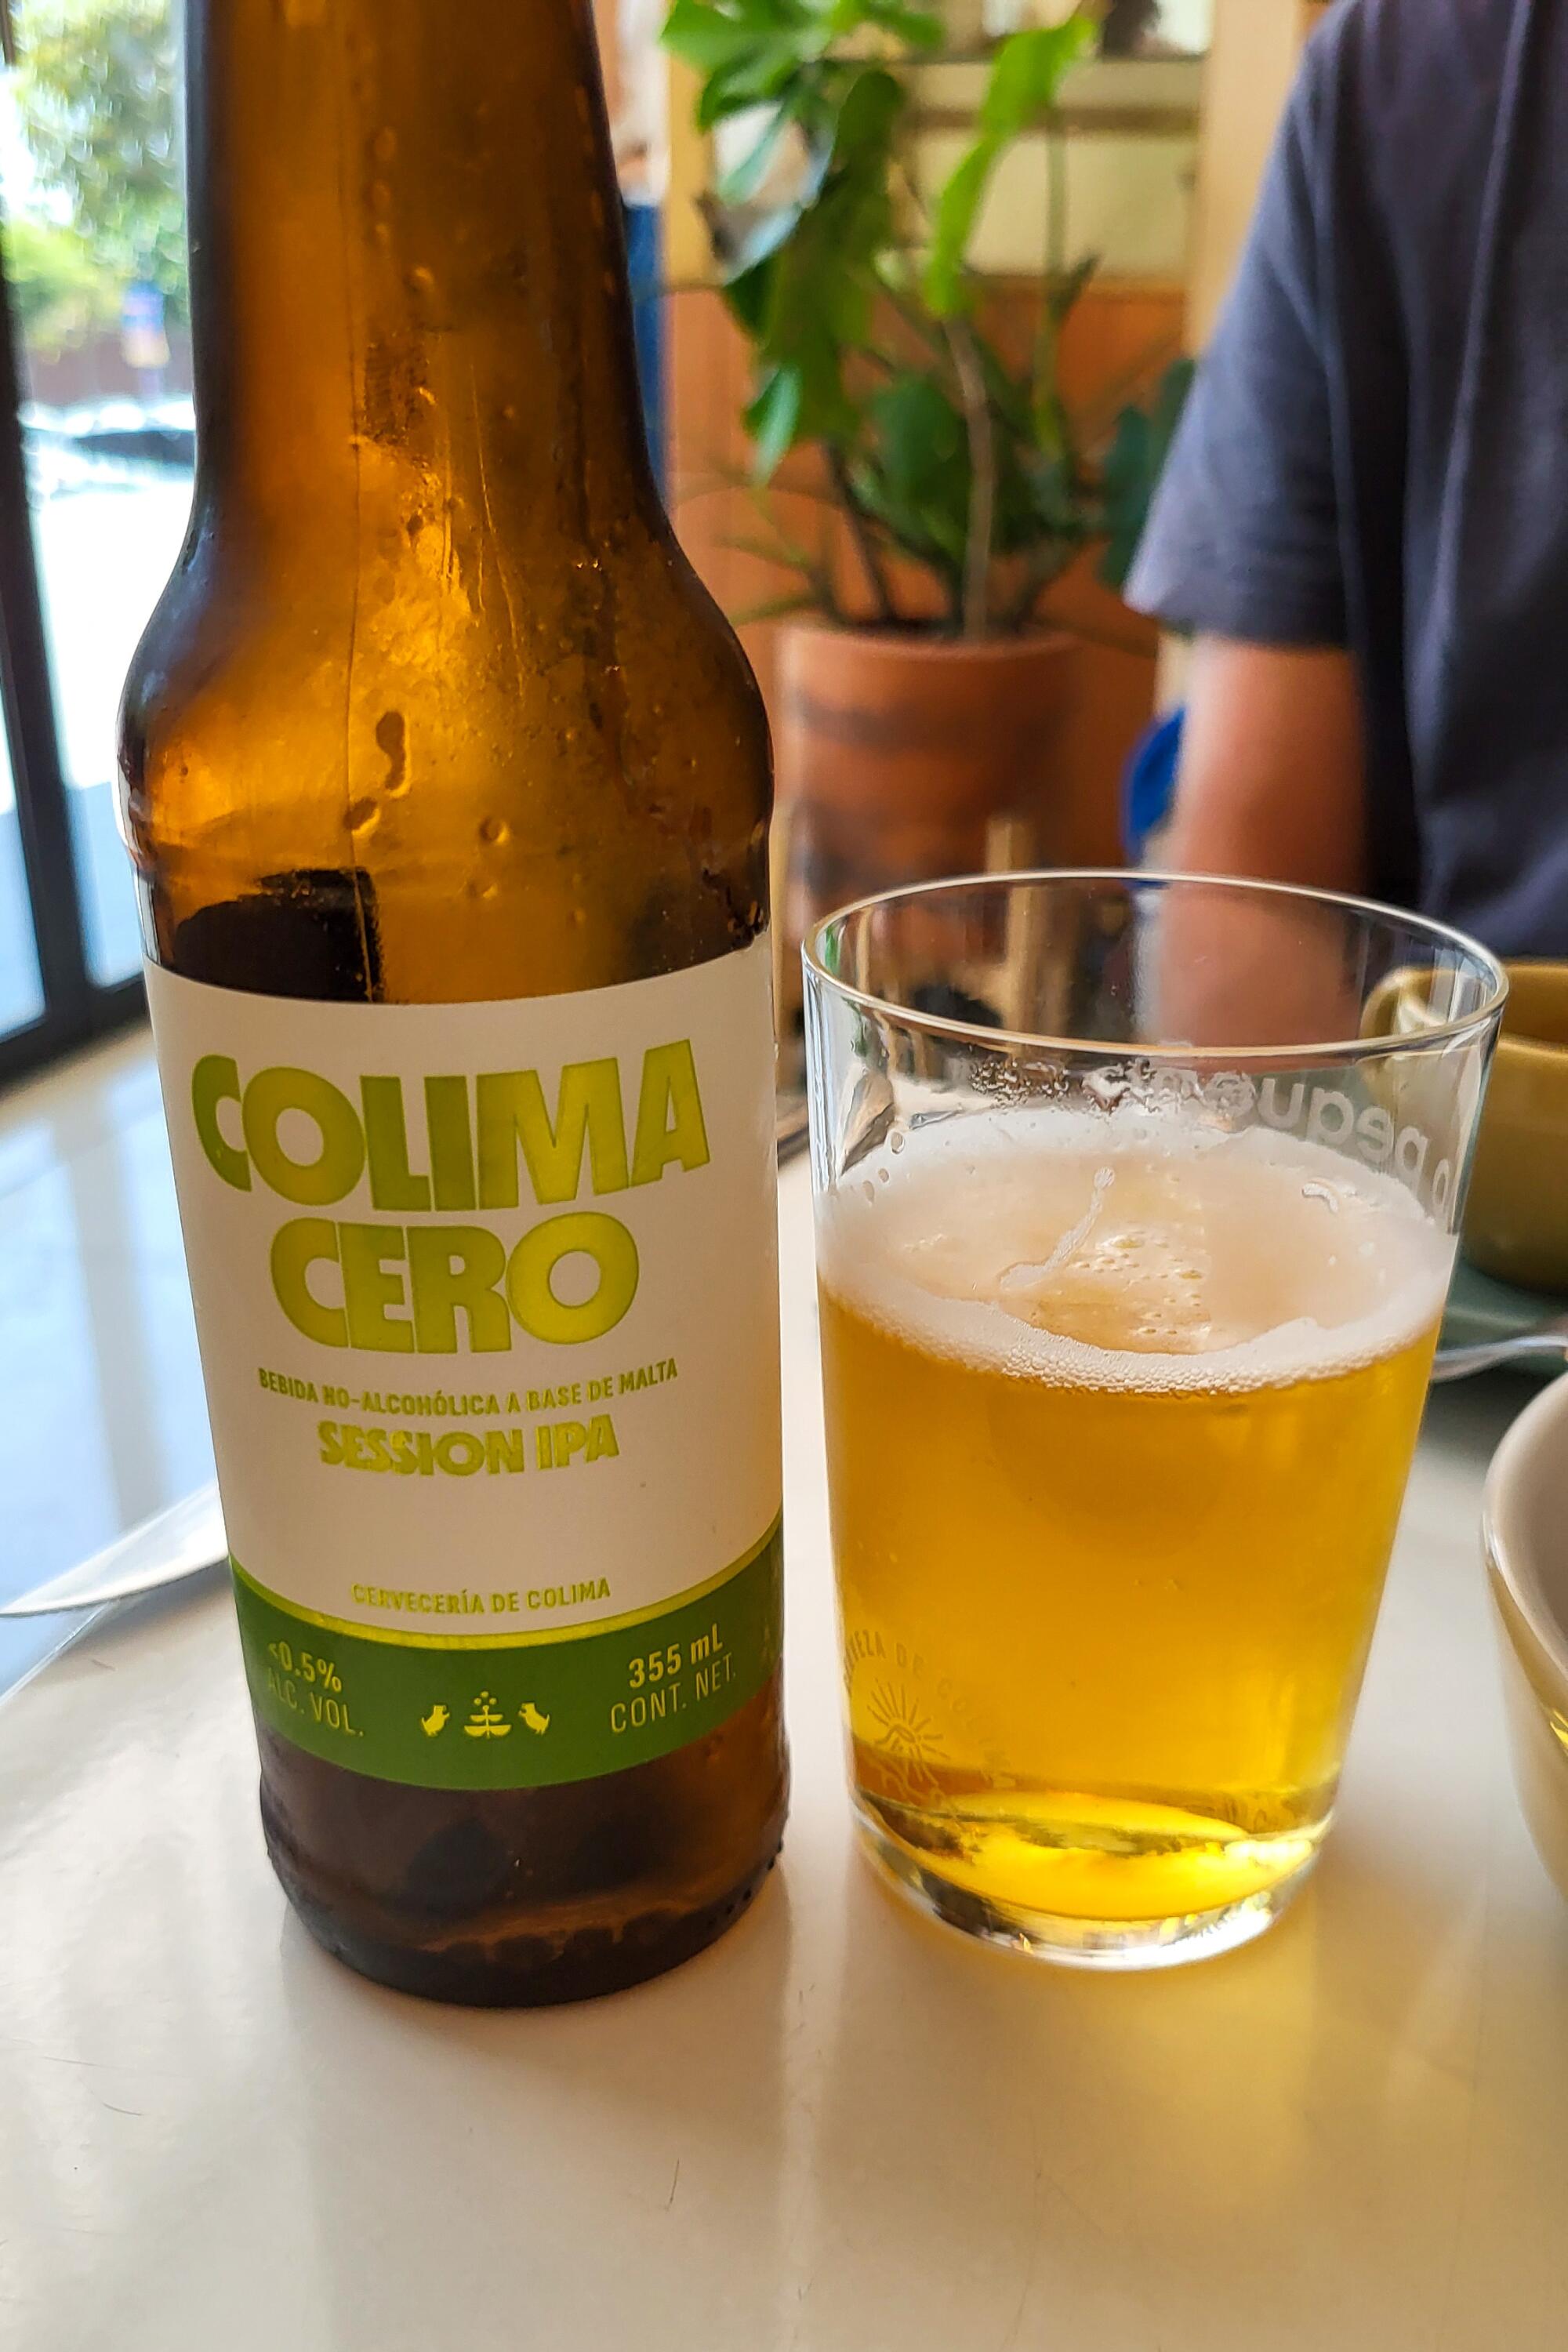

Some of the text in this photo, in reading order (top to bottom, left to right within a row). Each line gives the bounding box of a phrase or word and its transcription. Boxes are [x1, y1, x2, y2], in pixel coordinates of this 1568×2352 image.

[191, 1039, 710, 1212] COLIMA
[270, 1211, 639, 1354] CERO
[258, 1358, 678, 1417] BEBIDA NO-ALCOHÓLICA A BASE DE MALTA
[317, 1414, 619, 1476] SESSION IPA
[351, 1577, 611, 1614] CERVECERÍA DE COLIMA
[629, 1622, 723, 1689] 355 mL
[268, 1667, 364, 1737] ALC. VOL.
[611, 1652, 737, 1733] CONT. NET.
